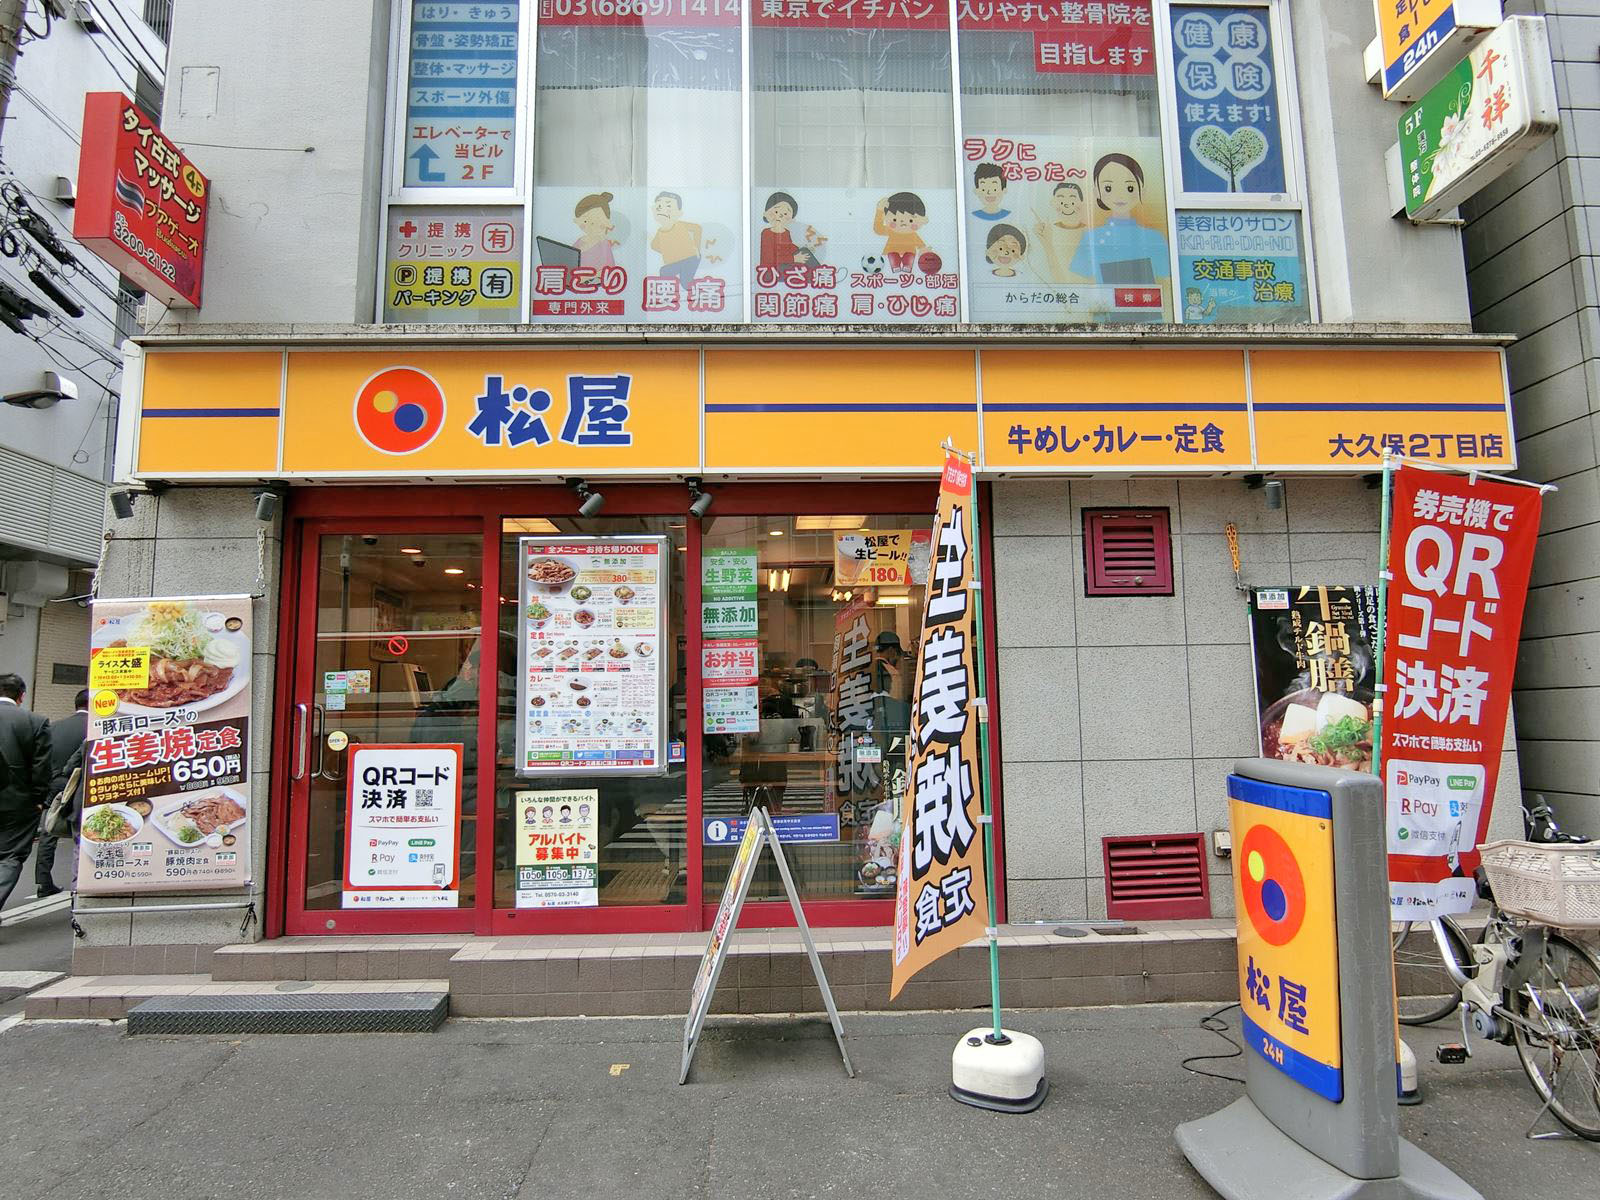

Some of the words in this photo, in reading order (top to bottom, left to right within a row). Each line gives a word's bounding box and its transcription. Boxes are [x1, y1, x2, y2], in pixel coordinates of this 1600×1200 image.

[555, 0, 741, 16] 03(6869)1414
[761, 0, 934, 18] 東京でイチバン
[415, 33, 515, 49] 骨盤・姿勢矯正
[1184, 19, 1259, 49] 健康
[1039, 43, 1148, 66] 目指します
[1403, 30, 1438, 73] 24h
[414, 61, 514, 76] 整体・マッサージ
[1187, 62, 1261, 92] 保険
[415, 90, 510, 105] スポーツ外傷
[1405, 107, 1423, 135] 5F
[122, 107, 181, 179] タイ古式
[412, 126, 512, 141] エレベーターで
[455, 143, 503, 159] 当ビル
[963, 139, 1036, 160] ラクに
[462, 165, 494, 180] 2F
[133, 149, 201, 223] マッサージ
[427, 222, 472, 238] 提携
[1178, 216, 1292, 231] 美容はりサロン
[488, 229, 510, 249] 有
[113, 221, 177, 283] 3200-2122
[398, 244, 474, 258] クリニック
[424, 267, 472, 285] 提携
[756, 264, 836, 289] ひざ痛
[1192, 259, 1276, 280] 交通事故
[487, 274, 508, 295] 有
[536, 265, 628, 296] 肩こり
[851, 273, 958, 289] スポーツ・部活
[393, 290, 477, 307] パーキング
[642, 277, 725, 312] 腰痛
[1005, 291, 1080, 304] からだの総合
[1124, 293, 1152, 303] 検索
[1253, 280, 1296, 303] 治療
[547, 301, 610, 315] 専門外来
[755, 293, 839, 318] 関節痛
[851, 294, 957, 317] 肩・ひじ痛
[467, 374, 632, 448] 松屋
[1008, 423, 1224, 454] 牛めし・カレー・定食
[1328, 433, 1503, 458] 大久保2丁目店
[1412, 488, 1514, 532] 券売機で
[548, 545, 644, 554] 全メニューお持ち帰りOK!
[864, 534, 900, 548] 松屋で
[1404, 524, 1504, 600] QR
[704, 567, 753, 583] 生野菜
[703, 606, 756, 624] 無添加
[1398, 593, 1498, 657] コード
[98, 657, 142, 669] ライス大盛
[704, 650, 755, 668] お弁当
[530, 675, 551, 683] カレー
[1394, 659, 1490, 726] 決済
[95, 698, 116, 708] New
[90, 726, 243, 774] 生姜焼定食
[1392, 733, 1483, 752] スマホで簡単お支払い
[173, 755, 241, 781] 650円
[362, 766, 450, 787] QRコード
[1408, 774, 1440, 787] PayPay
[361, 789, 408, 809] 決済
[1414, 800, 1438, 817] Pay
[377, 839, 400, 847] PayPay
[528, 832, 586, 846] アルバイト
[379, 854, 395, 864] Pay
[535, 847, 579, 861] 募集中
[1246, 955, 1309, 1036] 松屋
[1262, 1037, 1284, 1066] 24H
